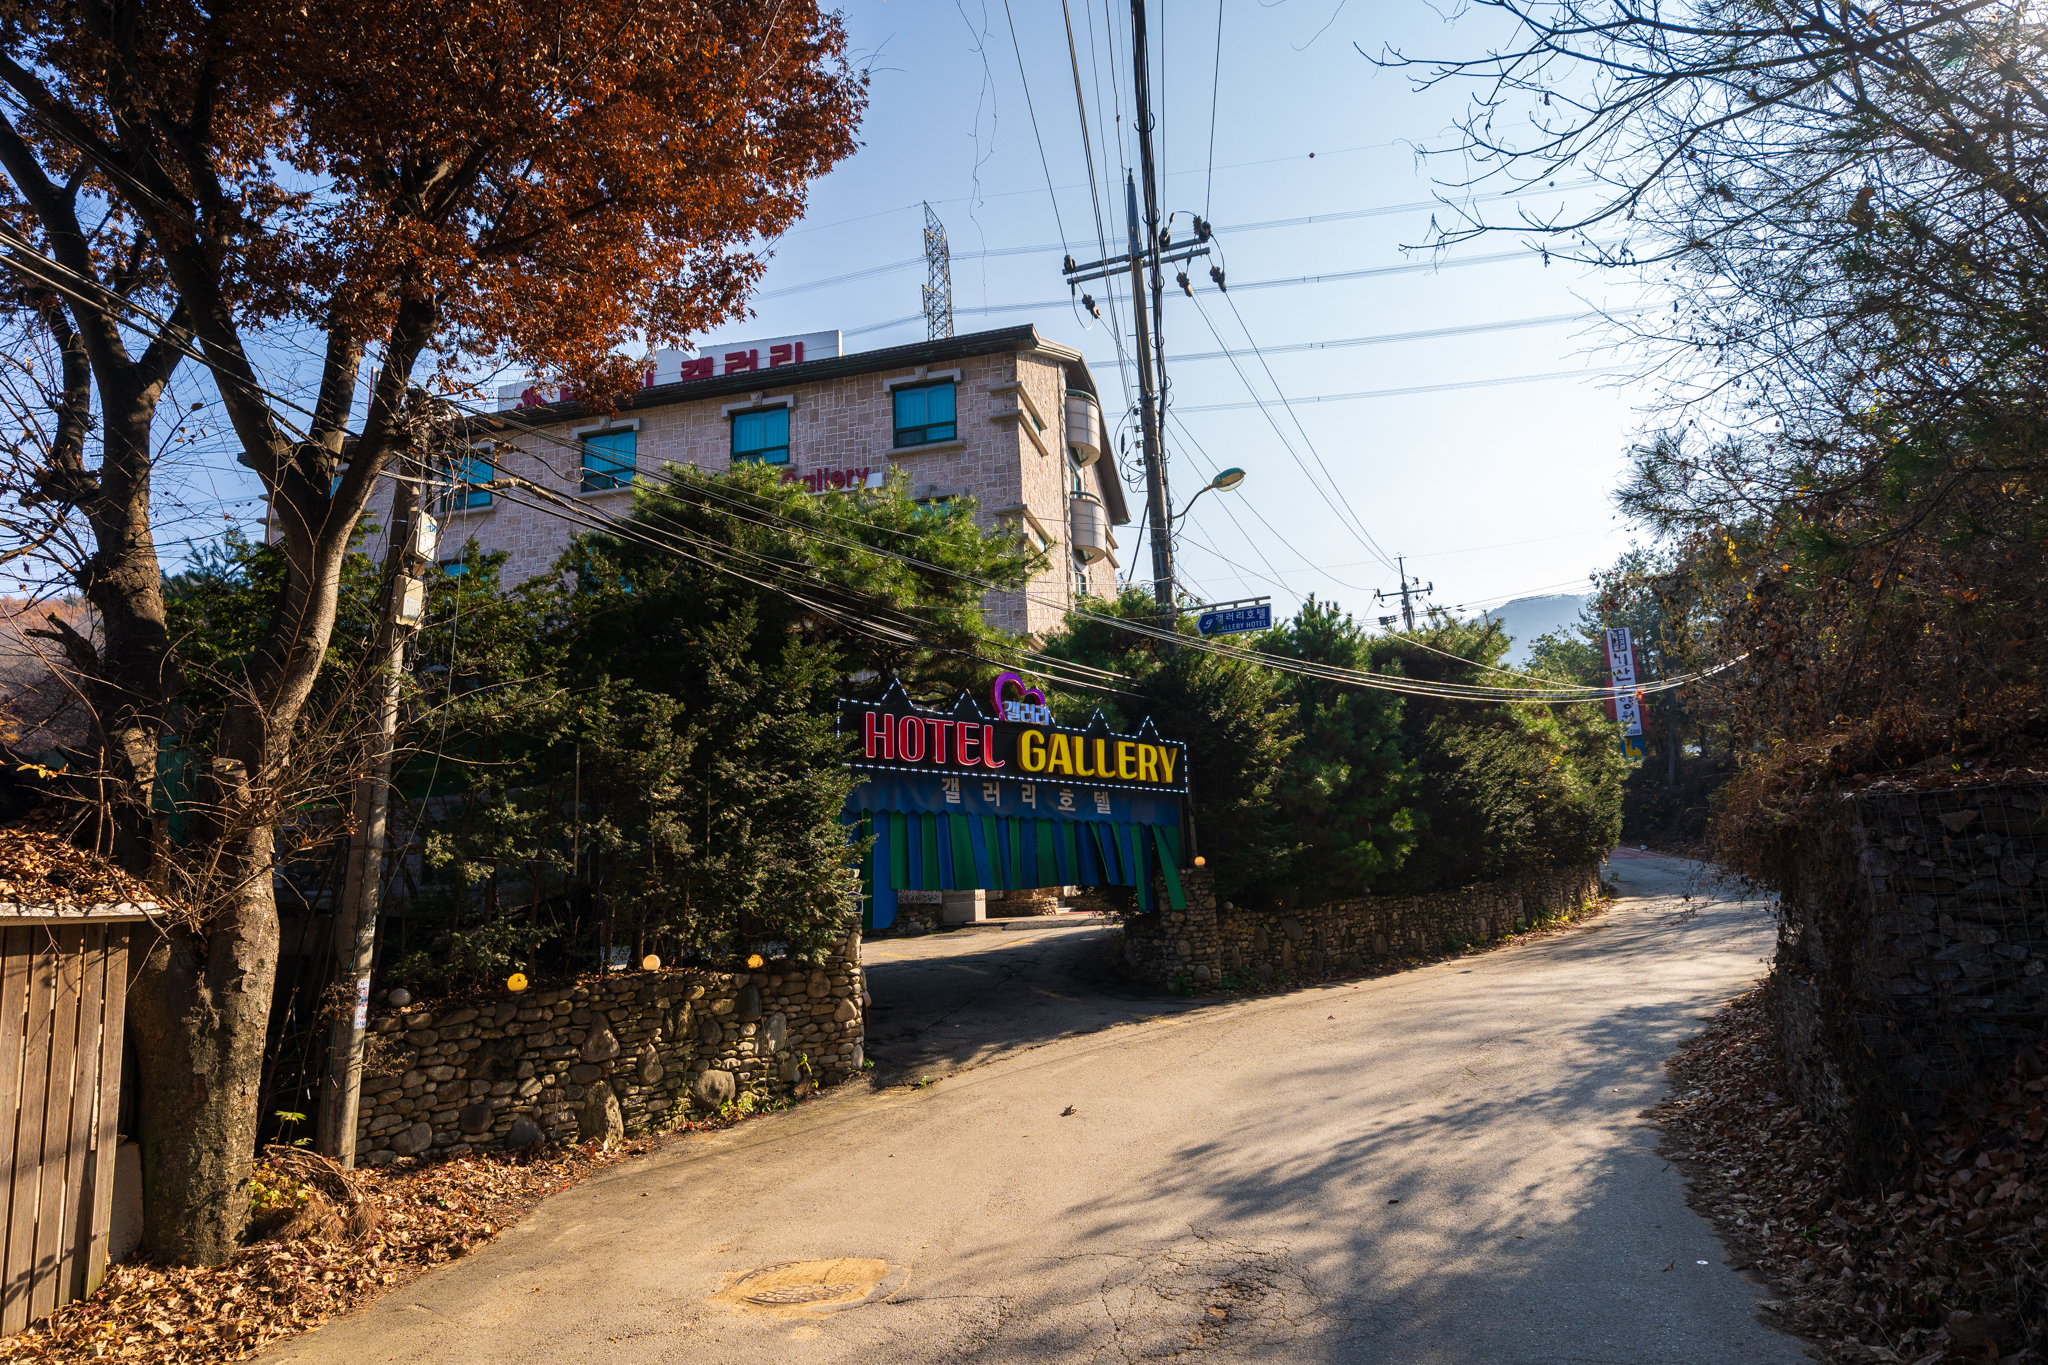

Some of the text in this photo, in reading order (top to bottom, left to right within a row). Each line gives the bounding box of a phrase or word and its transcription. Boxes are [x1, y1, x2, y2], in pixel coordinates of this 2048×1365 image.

[1216, 608, 1266, 624] 갤러리호텔
[1246, 620, 1267, 628] HOTEL
[1004, 700, 1050, 726] 갤러리
[863, 711, 1178, 783] HOTEL GALLERY
